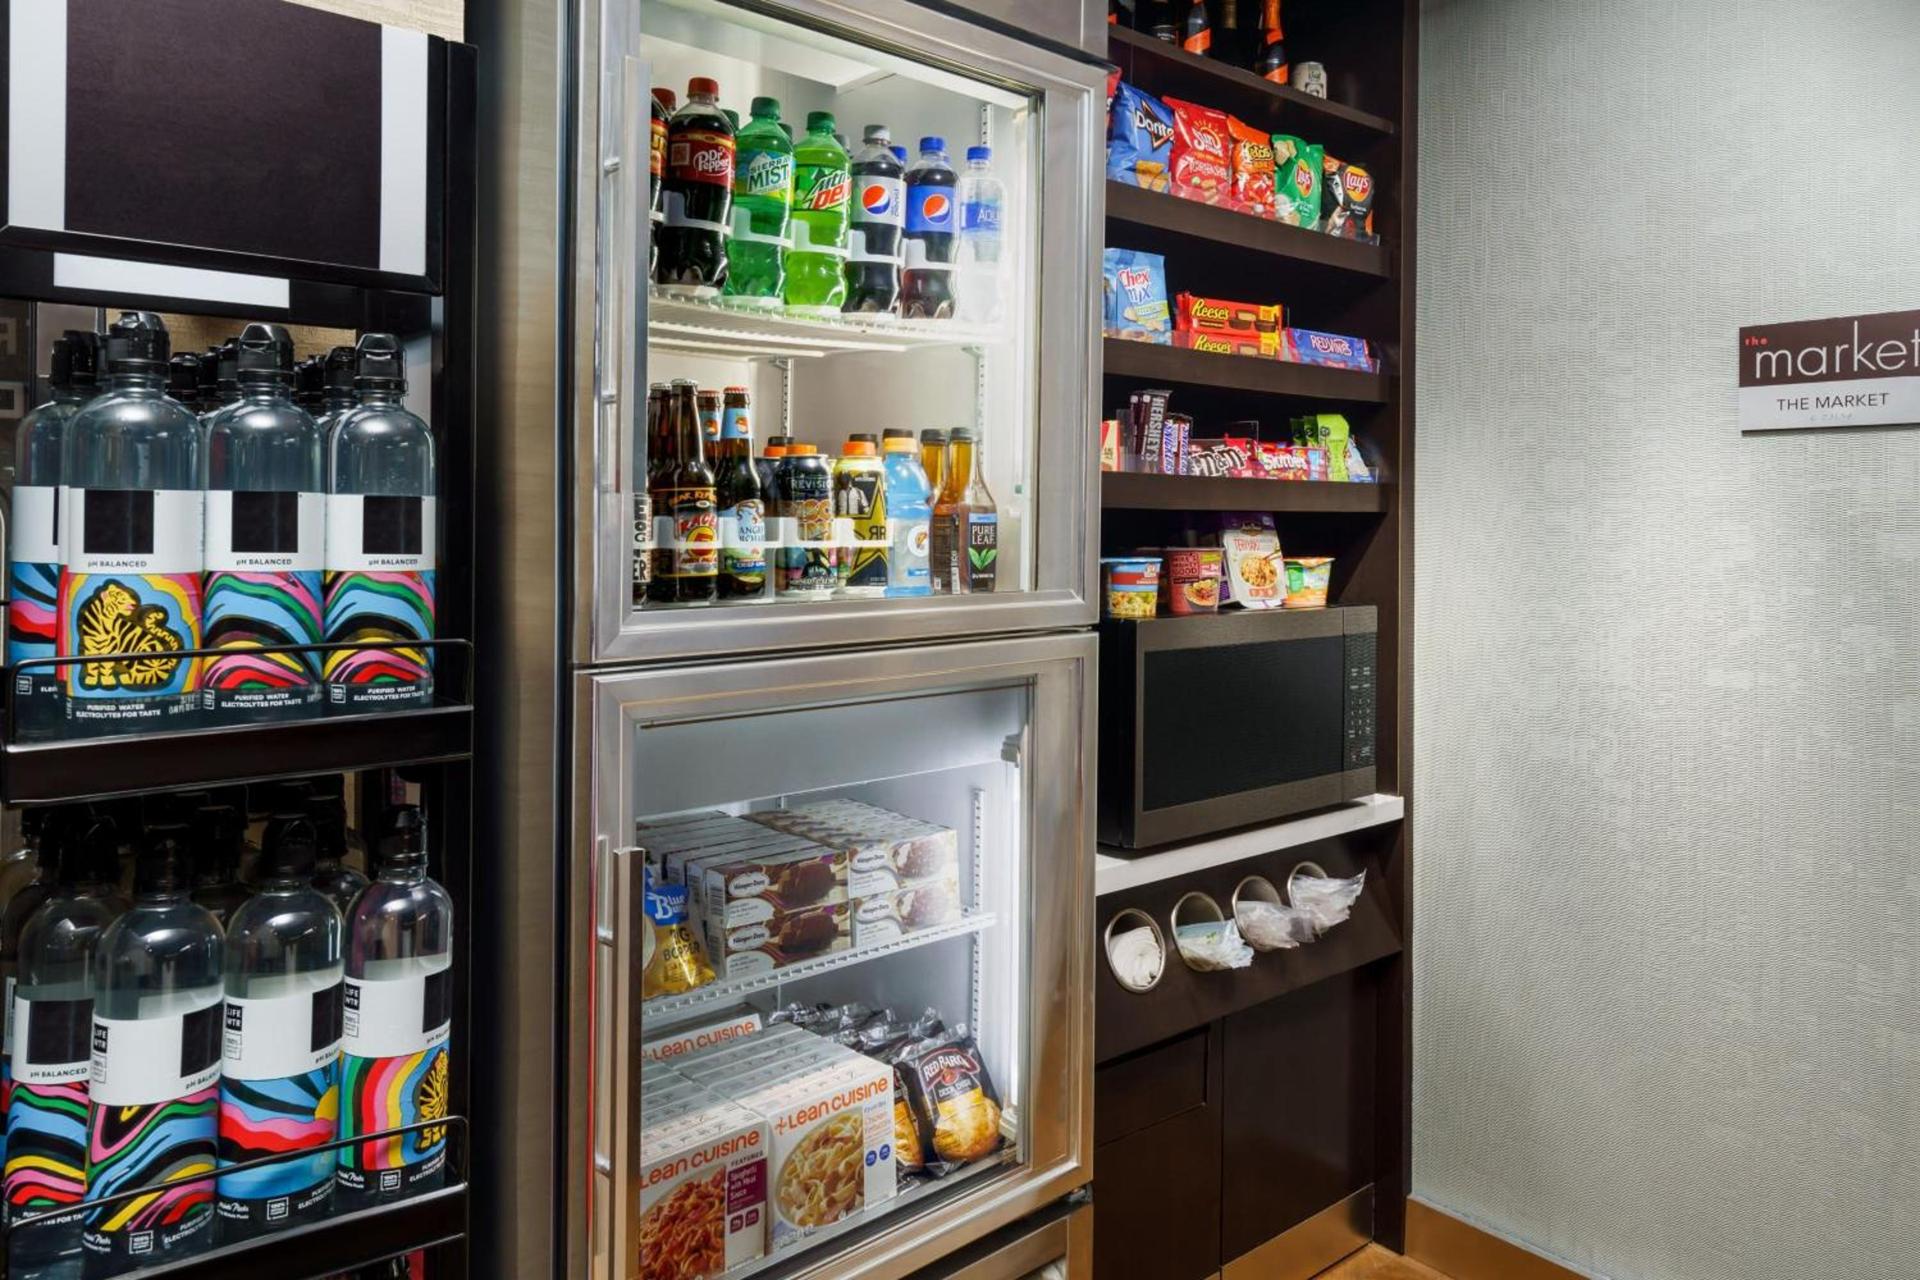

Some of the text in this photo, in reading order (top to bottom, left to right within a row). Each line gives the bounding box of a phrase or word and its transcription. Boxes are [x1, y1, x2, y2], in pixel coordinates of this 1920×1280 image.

[708, 148, 724, 161] Dr
[698, 152, 730, 172] Pepper
[749, 164, 789, 191] MIST
[1119, 268, 1149, 287] Chex
[1745, 336, 1768, 347] the
[1755, 320, 1920, 379] market
[1777, 393, 1890, 411] THE MARKET
[1145, 397, 1165, 461] HERSHEY'S
[972, 525, 995, 535] PURE
[972, 534, 994, 545] LEAF
[100, 560, 147, 568] BALANCED
[249, 558, 292, 566] BALANCED
[382, 558, 418, 566] BALANCED
[397, 685, 416, 693] WATER
[284, 698, 301, 706] TASTE
[139, 709, 161, 717] TASTE
[652, 1039, 695, 1061] Lean
[41, 1067, 87, 1078] BALANCED
[923, 1060, 940, 1081] RED
[788, 1101, 830, 1129] Lean
